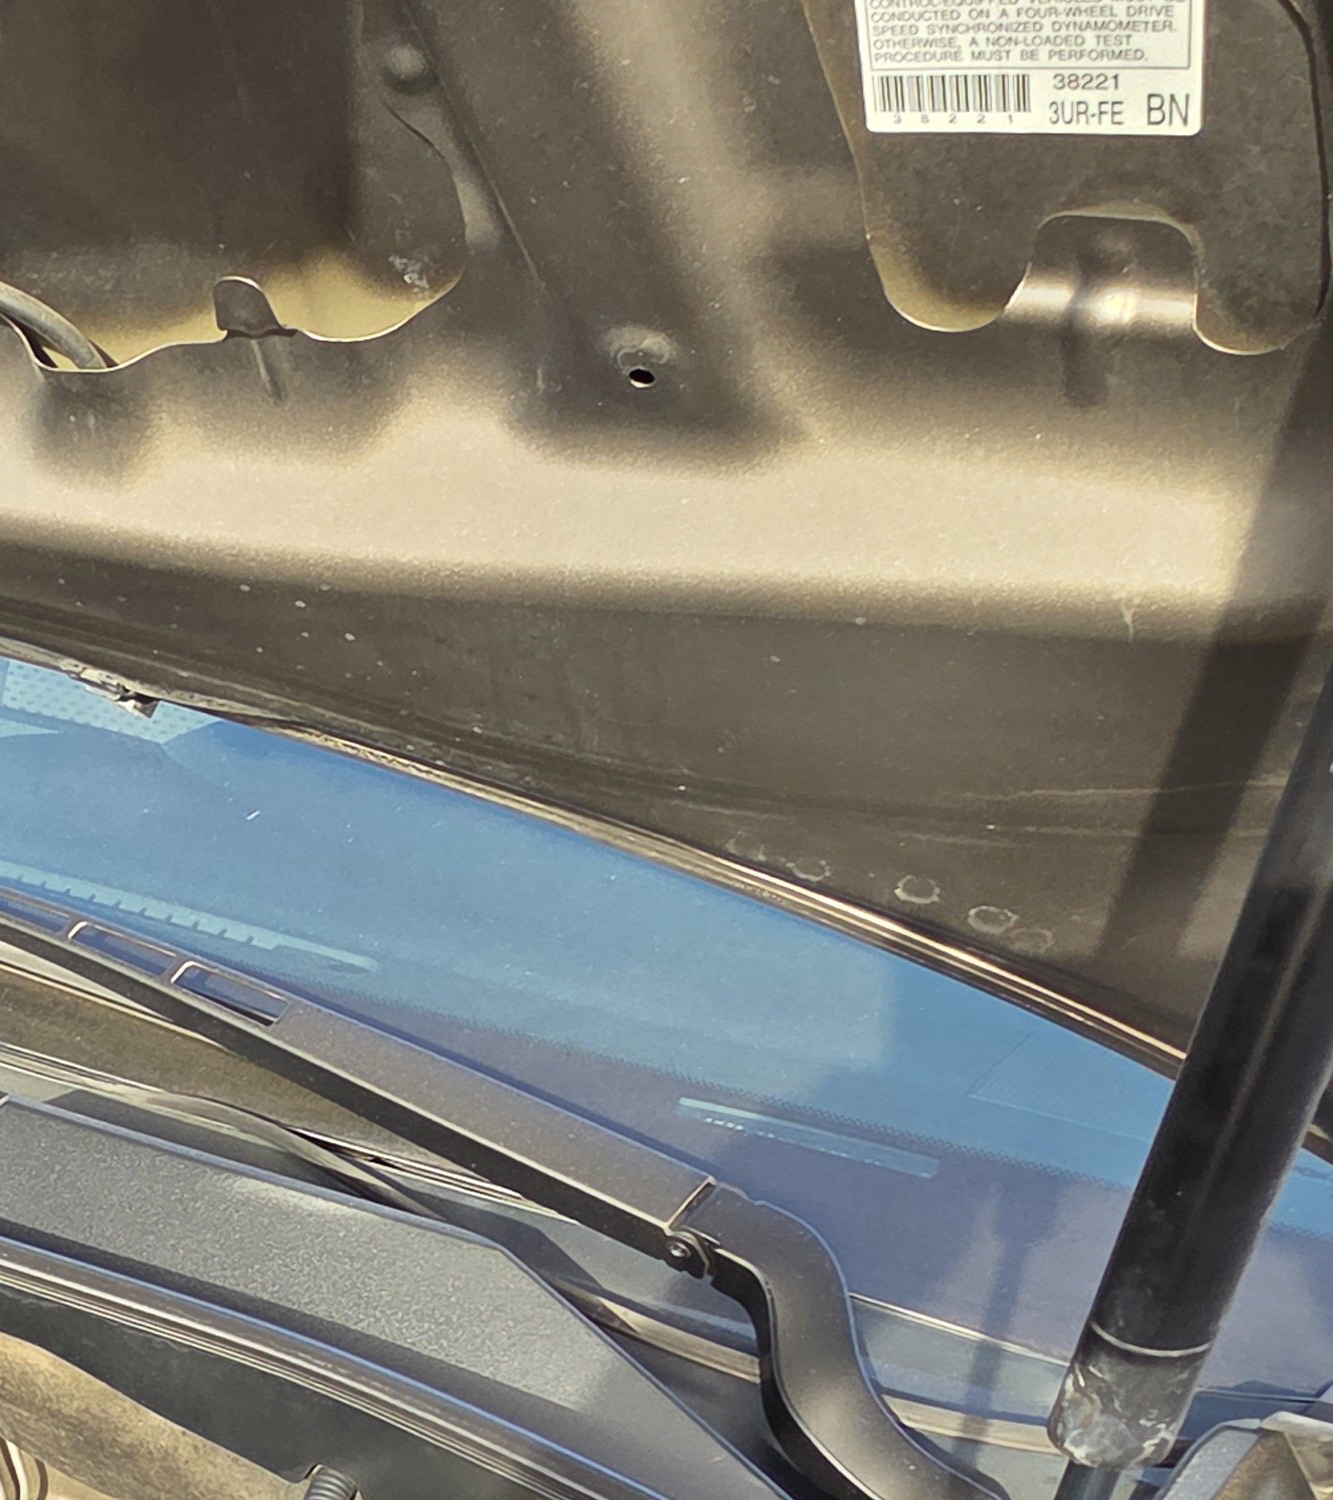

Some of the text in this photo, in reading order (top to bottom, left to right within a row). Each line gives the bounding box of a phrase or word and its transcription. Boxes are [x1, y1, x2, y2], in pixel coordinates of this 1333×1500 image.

[872, 4, 1174, 24] CONDUCTED ON A FOUR-WHEEL DRIVE
[873, 23, 919, 36] SPEED
[927, 21, 1043, 35] SYNCHRONIZED
[969, 36, 979, 48] A
[986, 35, 1085, 48] NON-LOADED
[1096, 34, 1131, 47] TEST
[874, 48, 1148, 63] PROCEDURE MUST BE PERFORMED.
[1053, 73, 1119, 90] 38221
[1049, 93, 1190, 126] 3UR-FE BN
